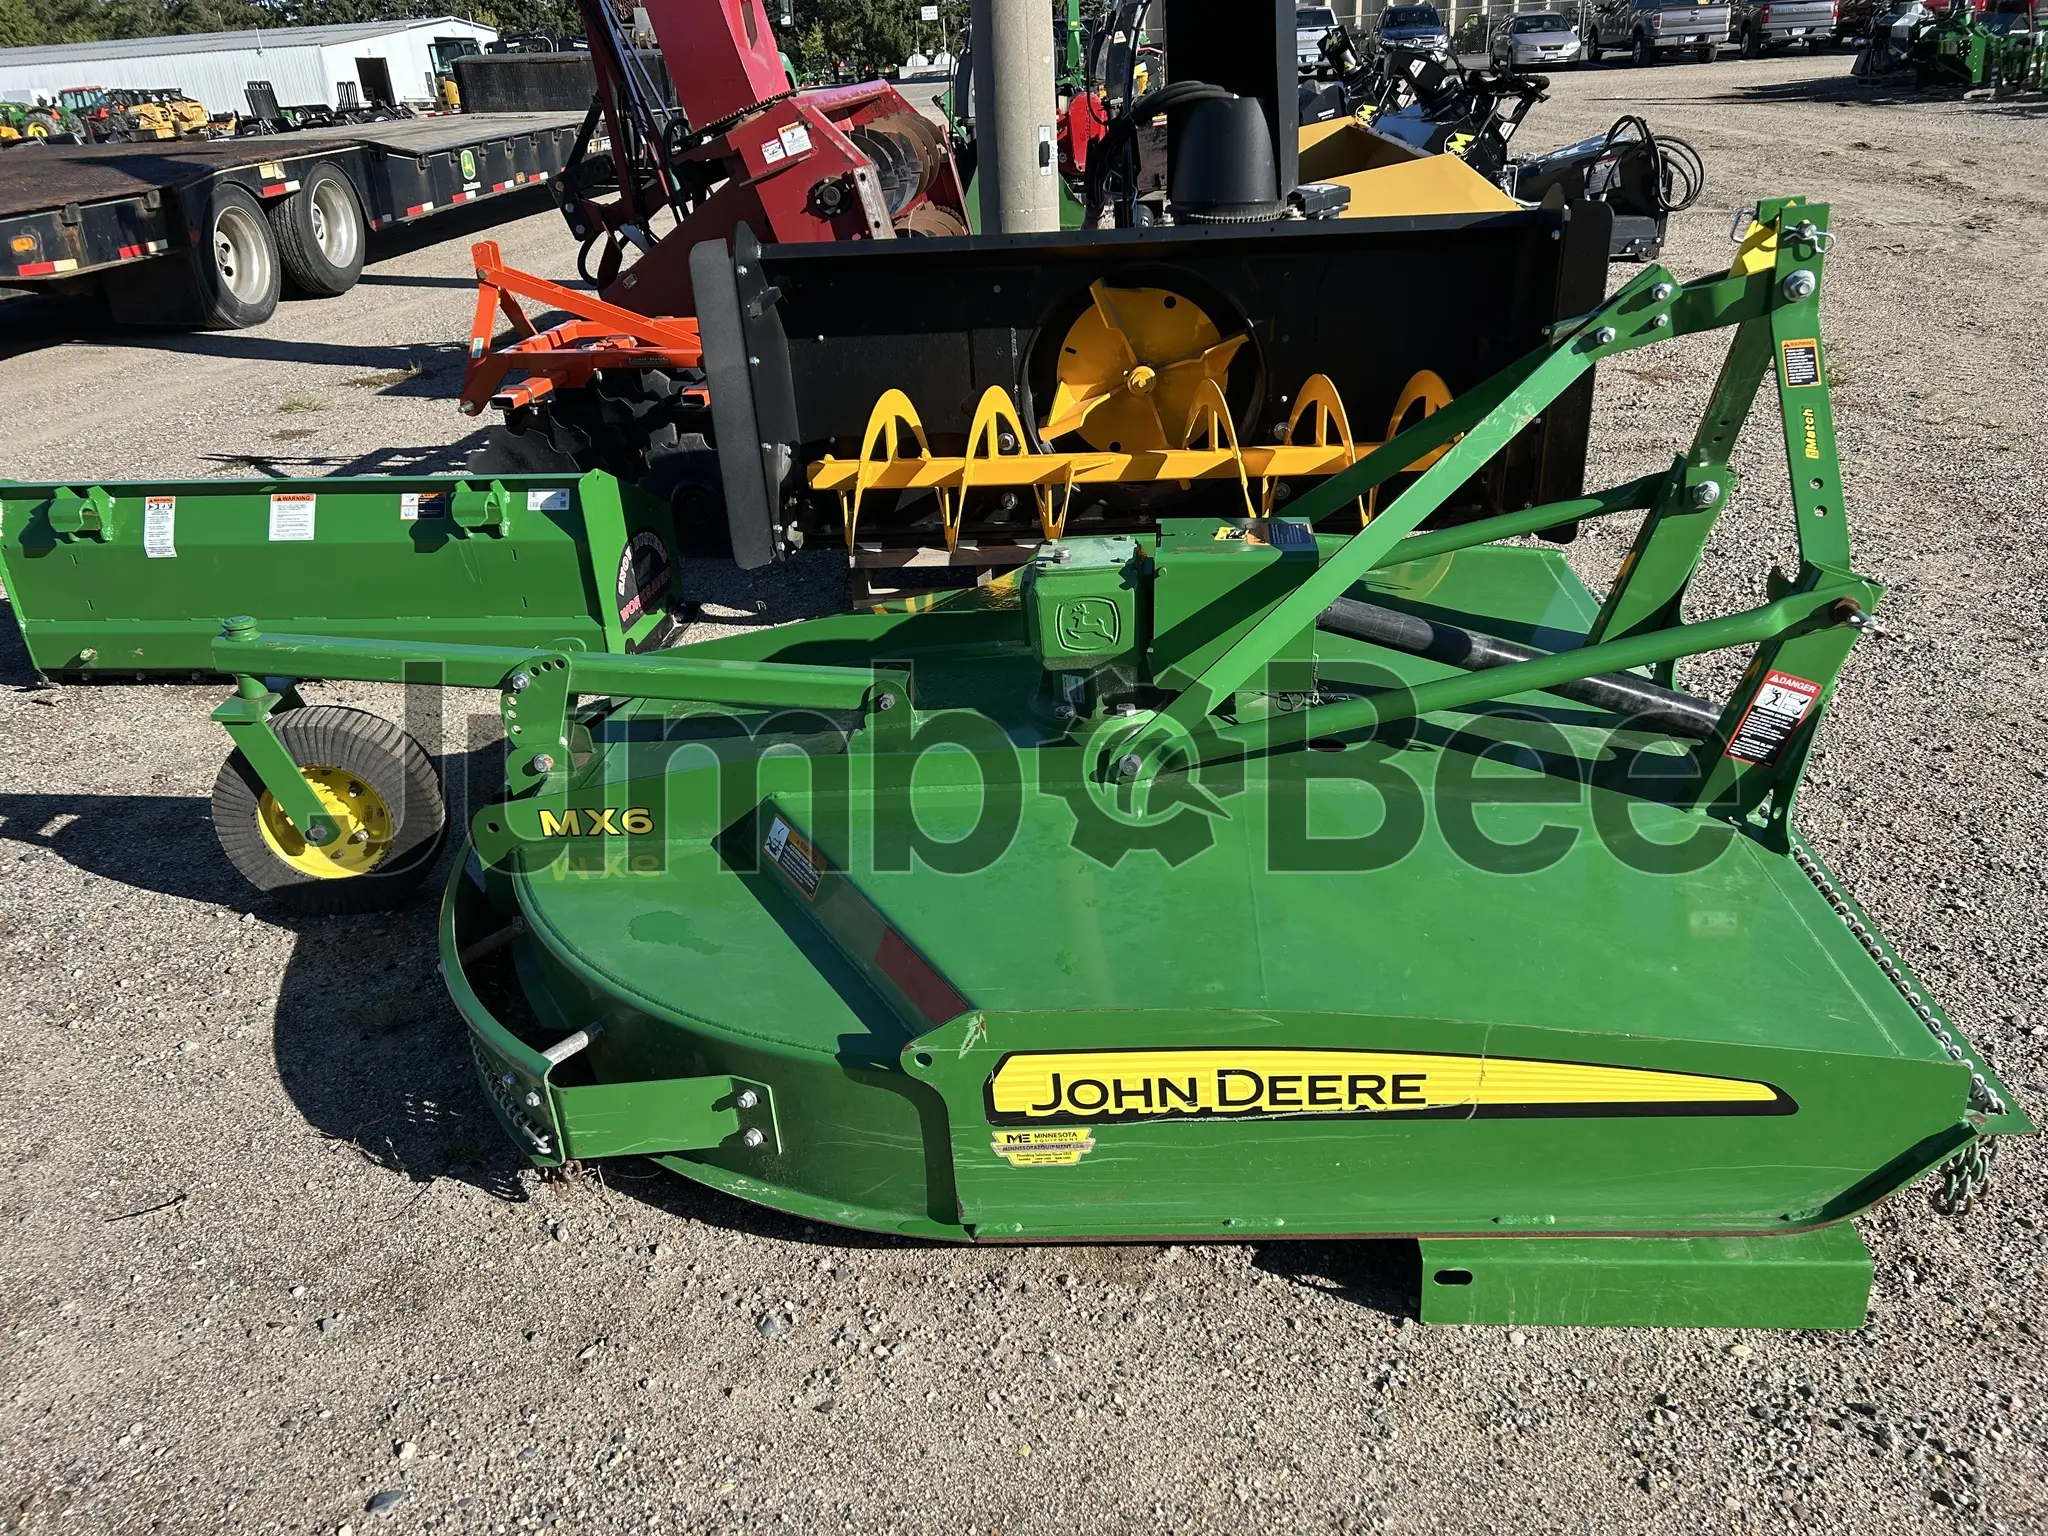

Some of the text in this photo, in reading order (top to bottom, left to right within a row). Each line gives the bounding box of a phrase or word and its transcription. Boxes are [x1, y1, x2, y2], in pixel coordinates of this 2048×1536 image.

[1779, 676, 1816, 693] DANGER
[538, 807, 655, 837] MX6
[1031, 1069, 1427, 1112] JOHN DEERE
[1034, 1131, 1078, 1139] MINNESOTA
